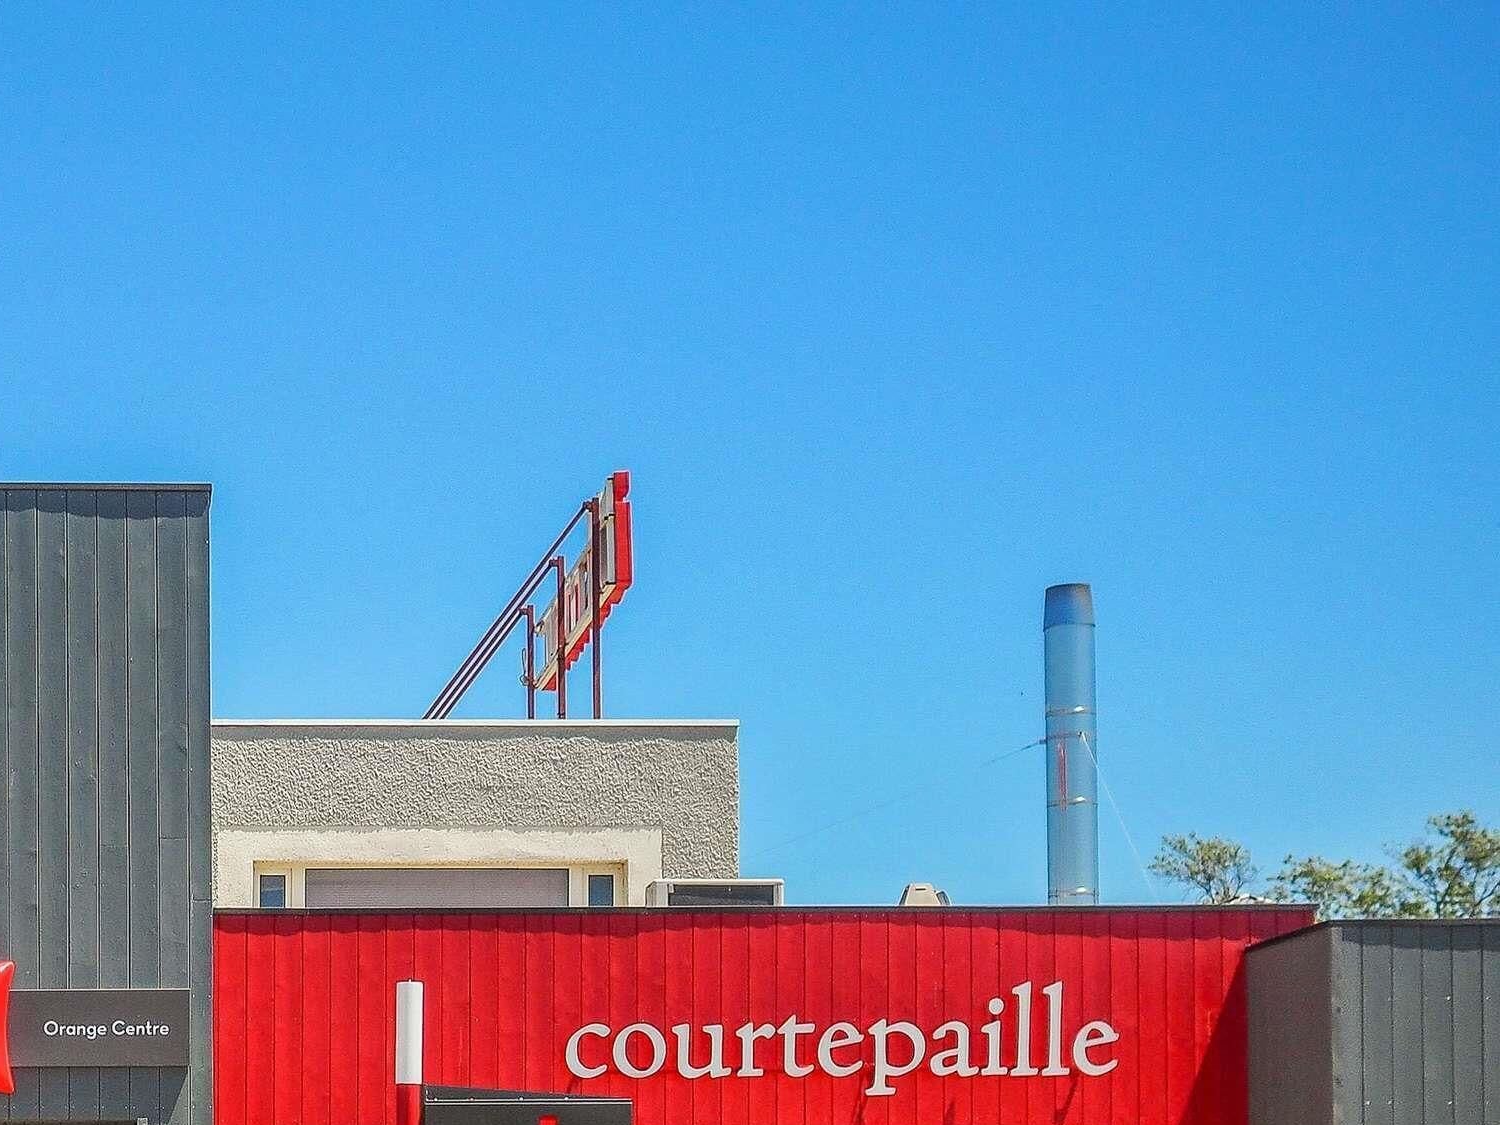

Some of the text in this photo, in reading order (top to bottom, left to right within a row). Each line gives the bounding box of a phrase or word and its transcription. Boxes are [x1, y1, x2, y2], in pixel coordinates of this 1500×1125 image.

[42, 1019, 170, 1040] Orange Centre
[564, 980, 1120, 1096] courtepaille
